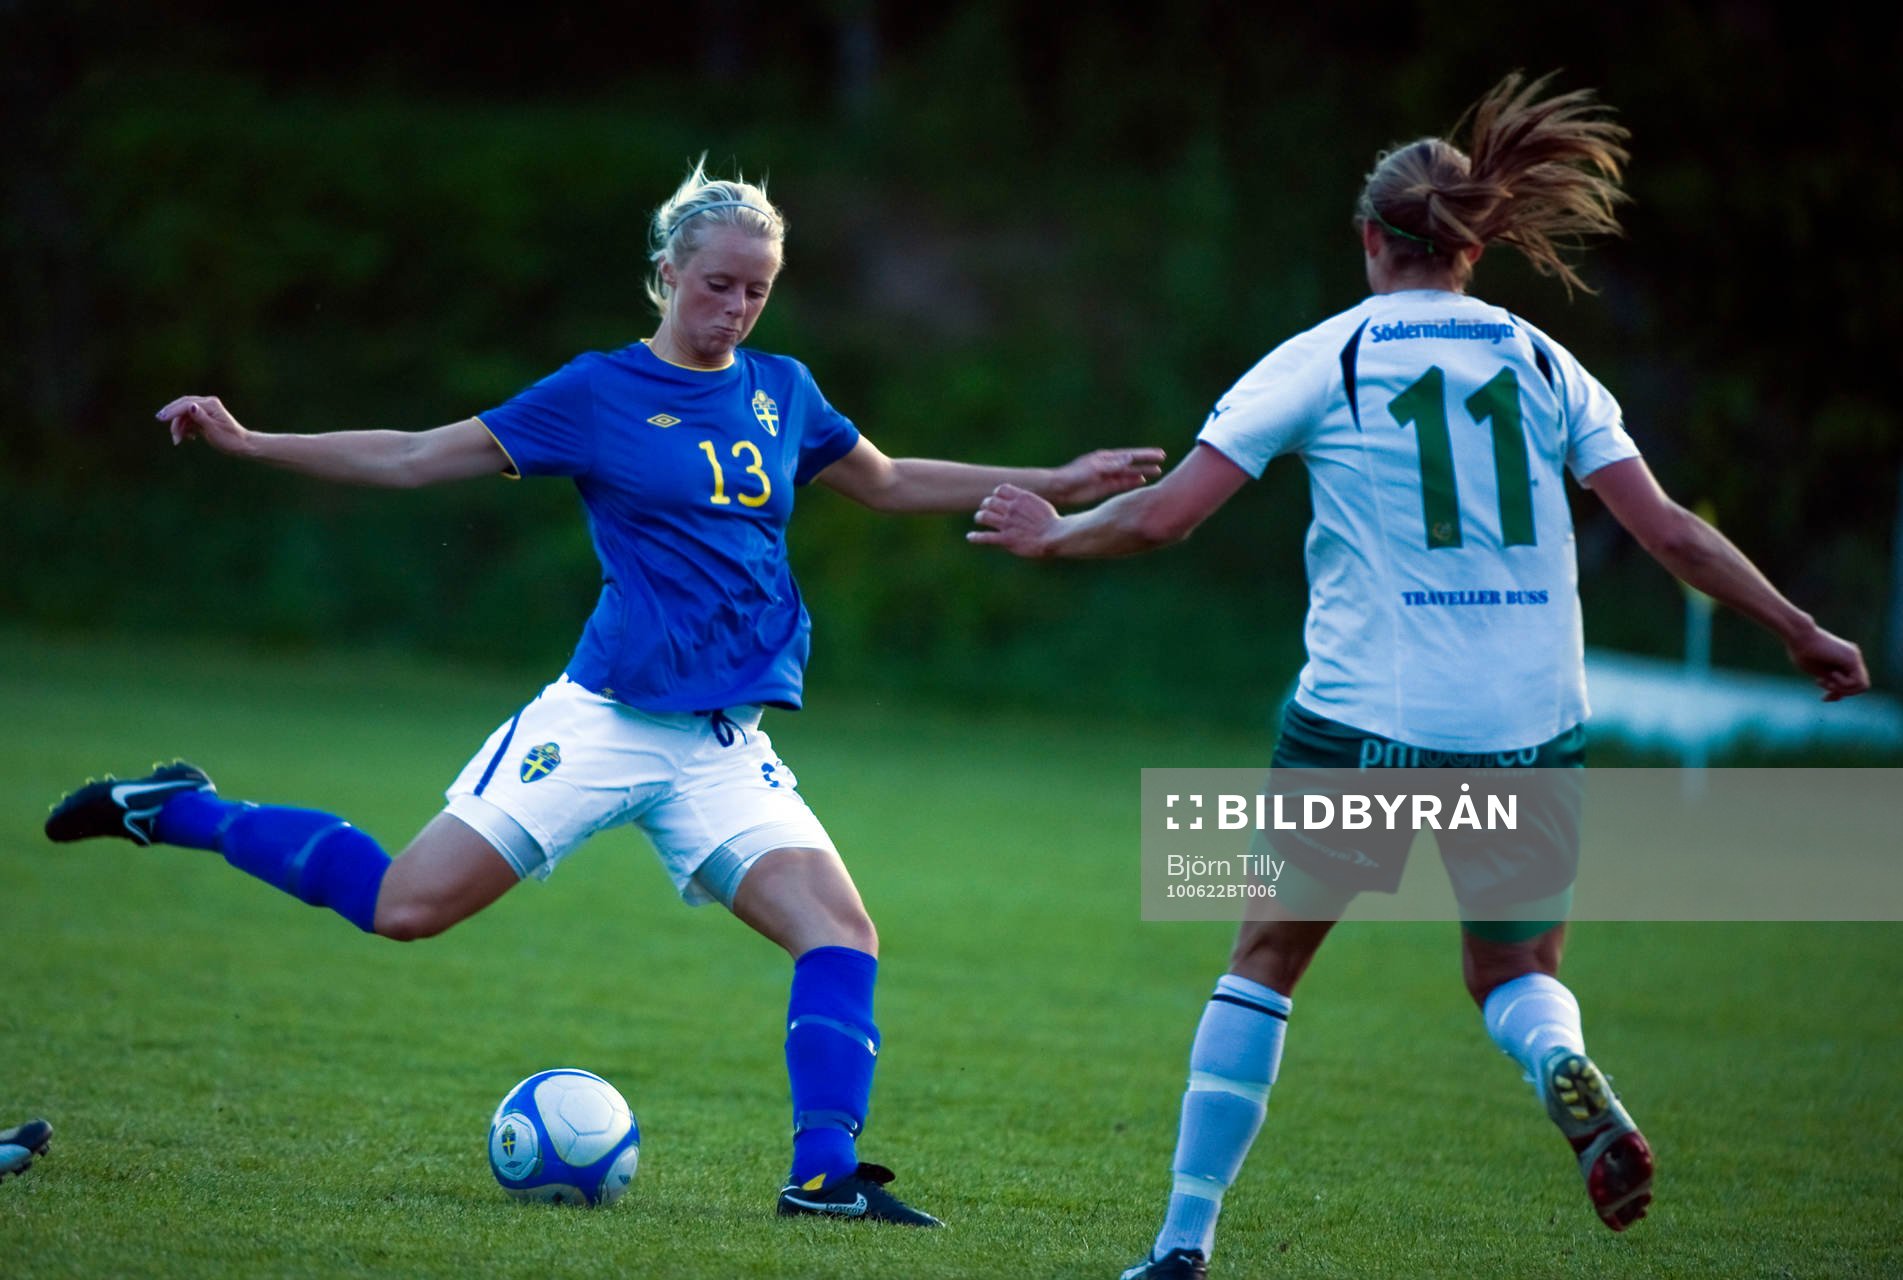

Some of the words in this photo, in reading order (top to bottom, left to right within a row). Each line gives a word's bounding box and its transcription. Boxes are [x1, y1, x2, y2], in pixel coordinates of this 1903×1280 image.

[698, 440, 771, 508] 13
[1388, 365, 1537, 550] 11
[1401, 590, 1502, 606] TRAVELLER
[1506, 590, 1549, 605] BUSS
